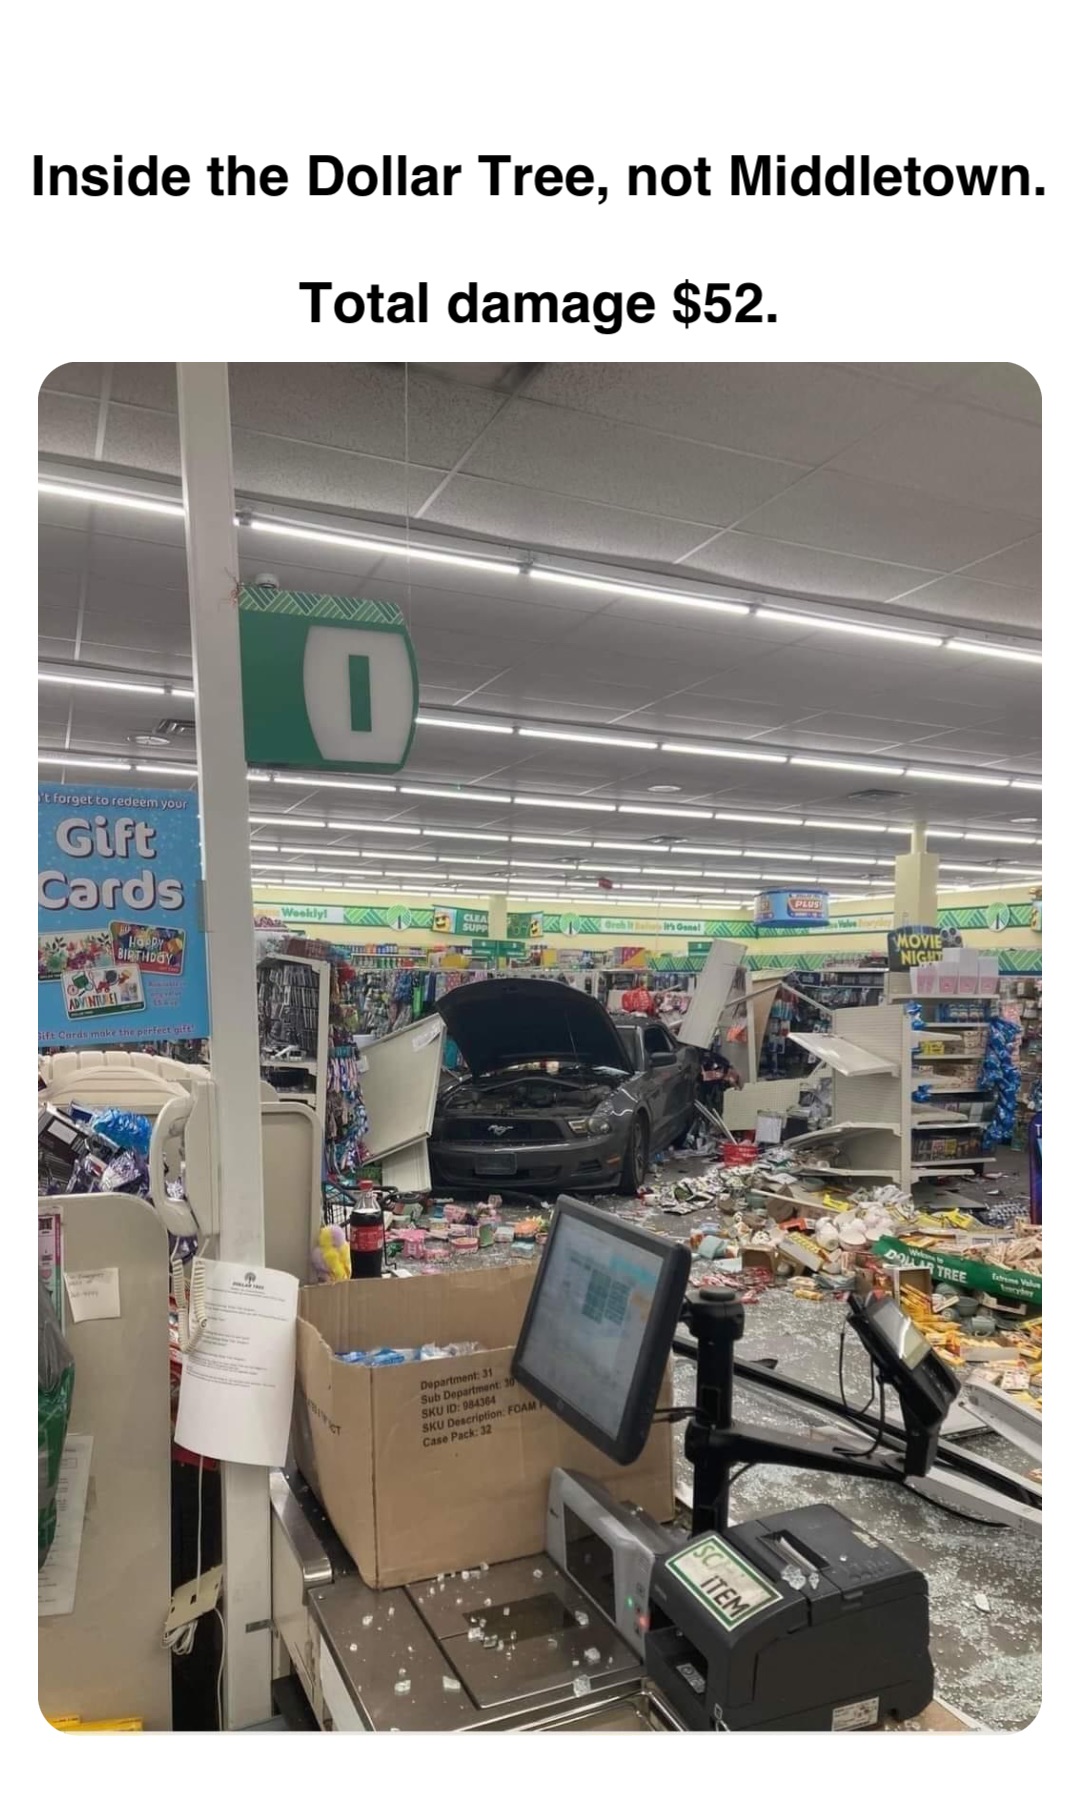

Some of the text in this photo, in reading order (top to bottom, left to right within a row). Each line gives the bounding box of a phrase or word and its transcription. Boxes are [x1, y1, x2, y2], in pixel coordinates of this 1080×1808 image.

[53, 792, 92, 806] forget
[96, 794, 109, 805] to
[112, 796, 158, 808] redeem
[161, 799, 187, 810] your
[56, 816, 156, 858] Gift
[38, 870, 185, 911] Cards
[281, 907, 328, 920] Weekly!
[897, 933, 942, 949] MOVIE
[901, 950, 942, 965] NIGHT
[58, 1030, 88, 1040] Cards
[91, 1027, 116, 1038] make
[119, 1026, 135, 1036] the
[137, 1025, 171, 1038] perfect
[937, 1266, 967, 1283] TREE
[420, 1367, 493, 1391] Department: 31
[420, 1394, 441, 1405] Sub
[443, 1381, 502, 1400] Department:
[421, 1406, 443, 1419] SKU
[446, 1403, 460, 1414] ID:
[422, 1420, 444, 1433] SKU
[447, 1409, 505, 1428] Description:
[507, 1401, 536, 1415] FOAM
[422, 1424, 492, 1448] Case Pack: 32
[701, 1575, 750, 1617] ITEM
